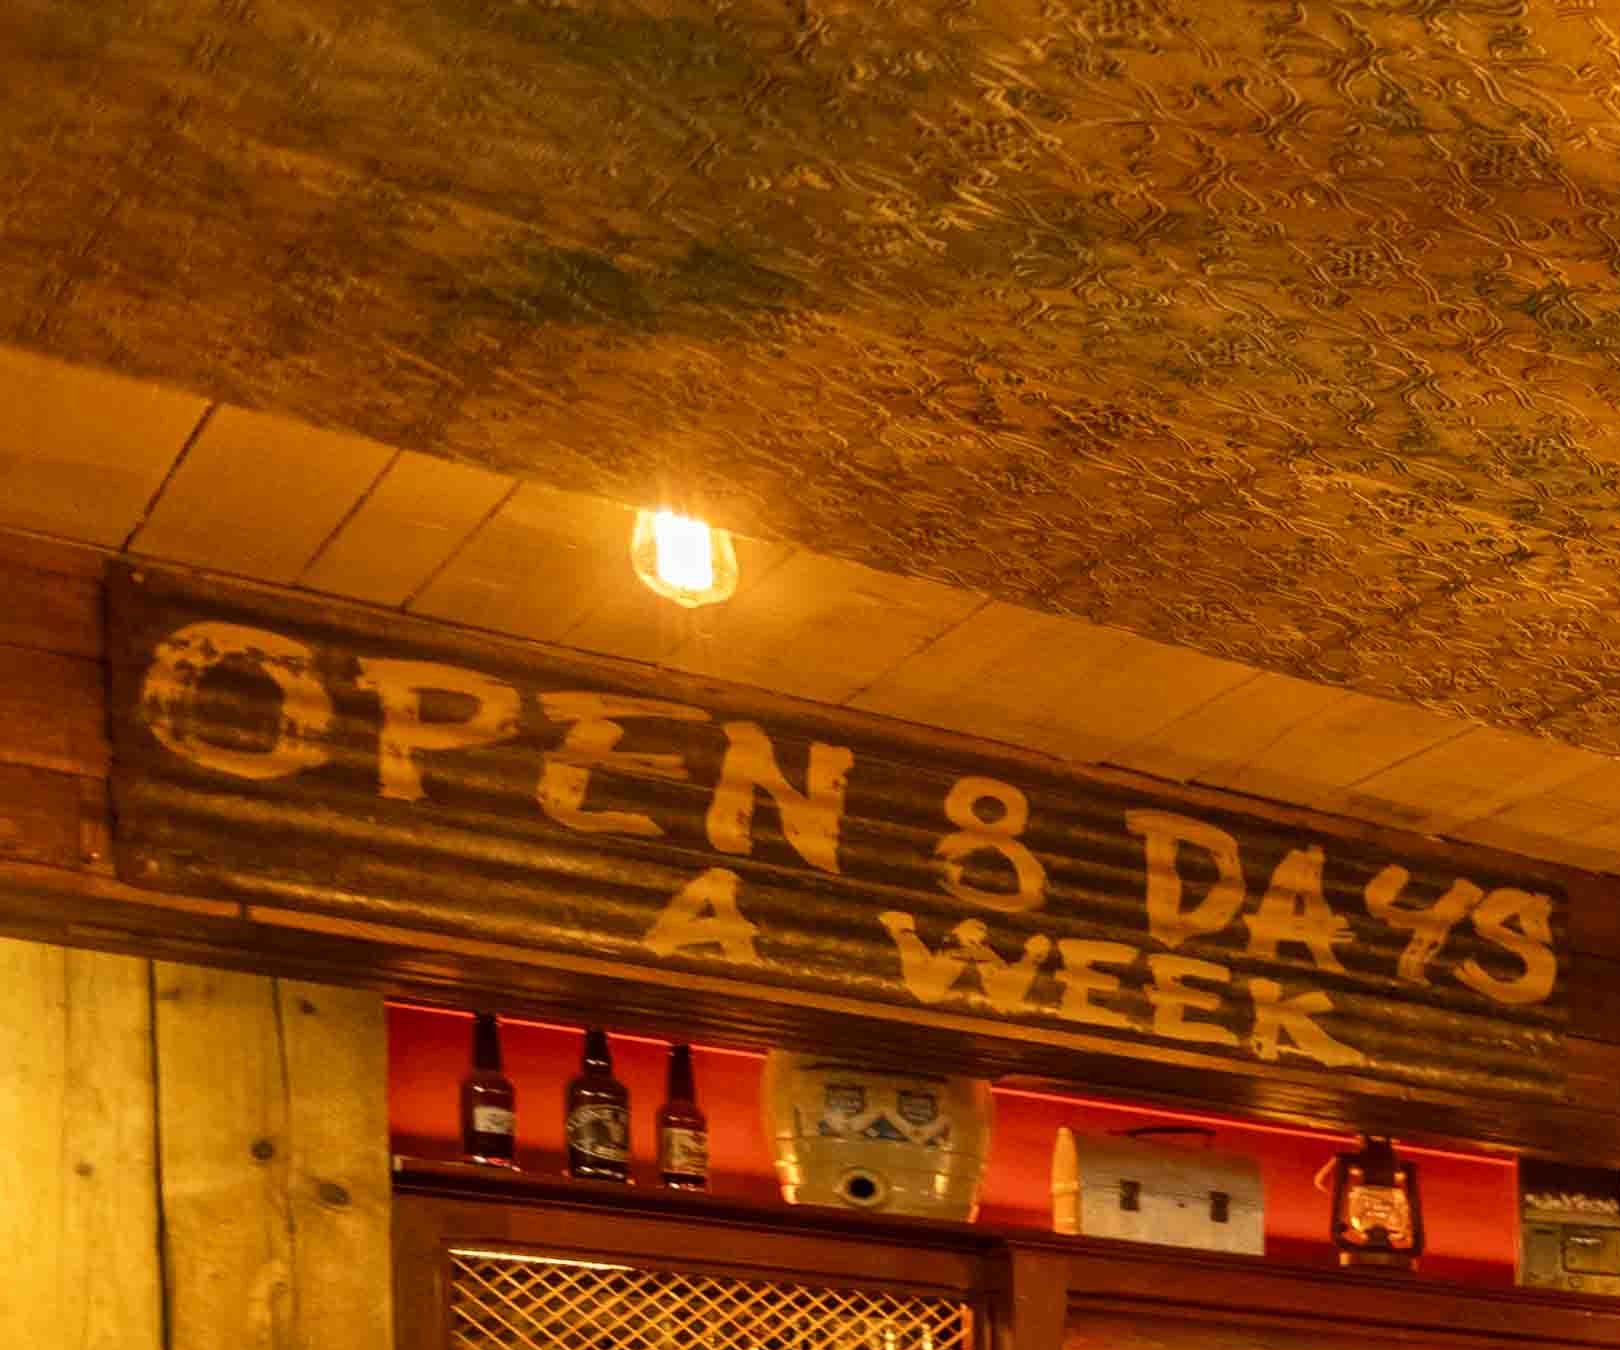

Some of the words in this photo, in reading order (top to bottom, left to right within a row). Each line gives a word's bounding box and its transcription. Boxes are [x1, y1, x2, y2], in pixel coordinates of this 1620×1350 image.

[141, 622, 853, 873] OPEN
[934, 776, 1046, 912] 8
[1126, 808, 1558, 1005] DAYS
[644, 868, 760, 968] A
[879, 910, 1366, 1068] WEEK
